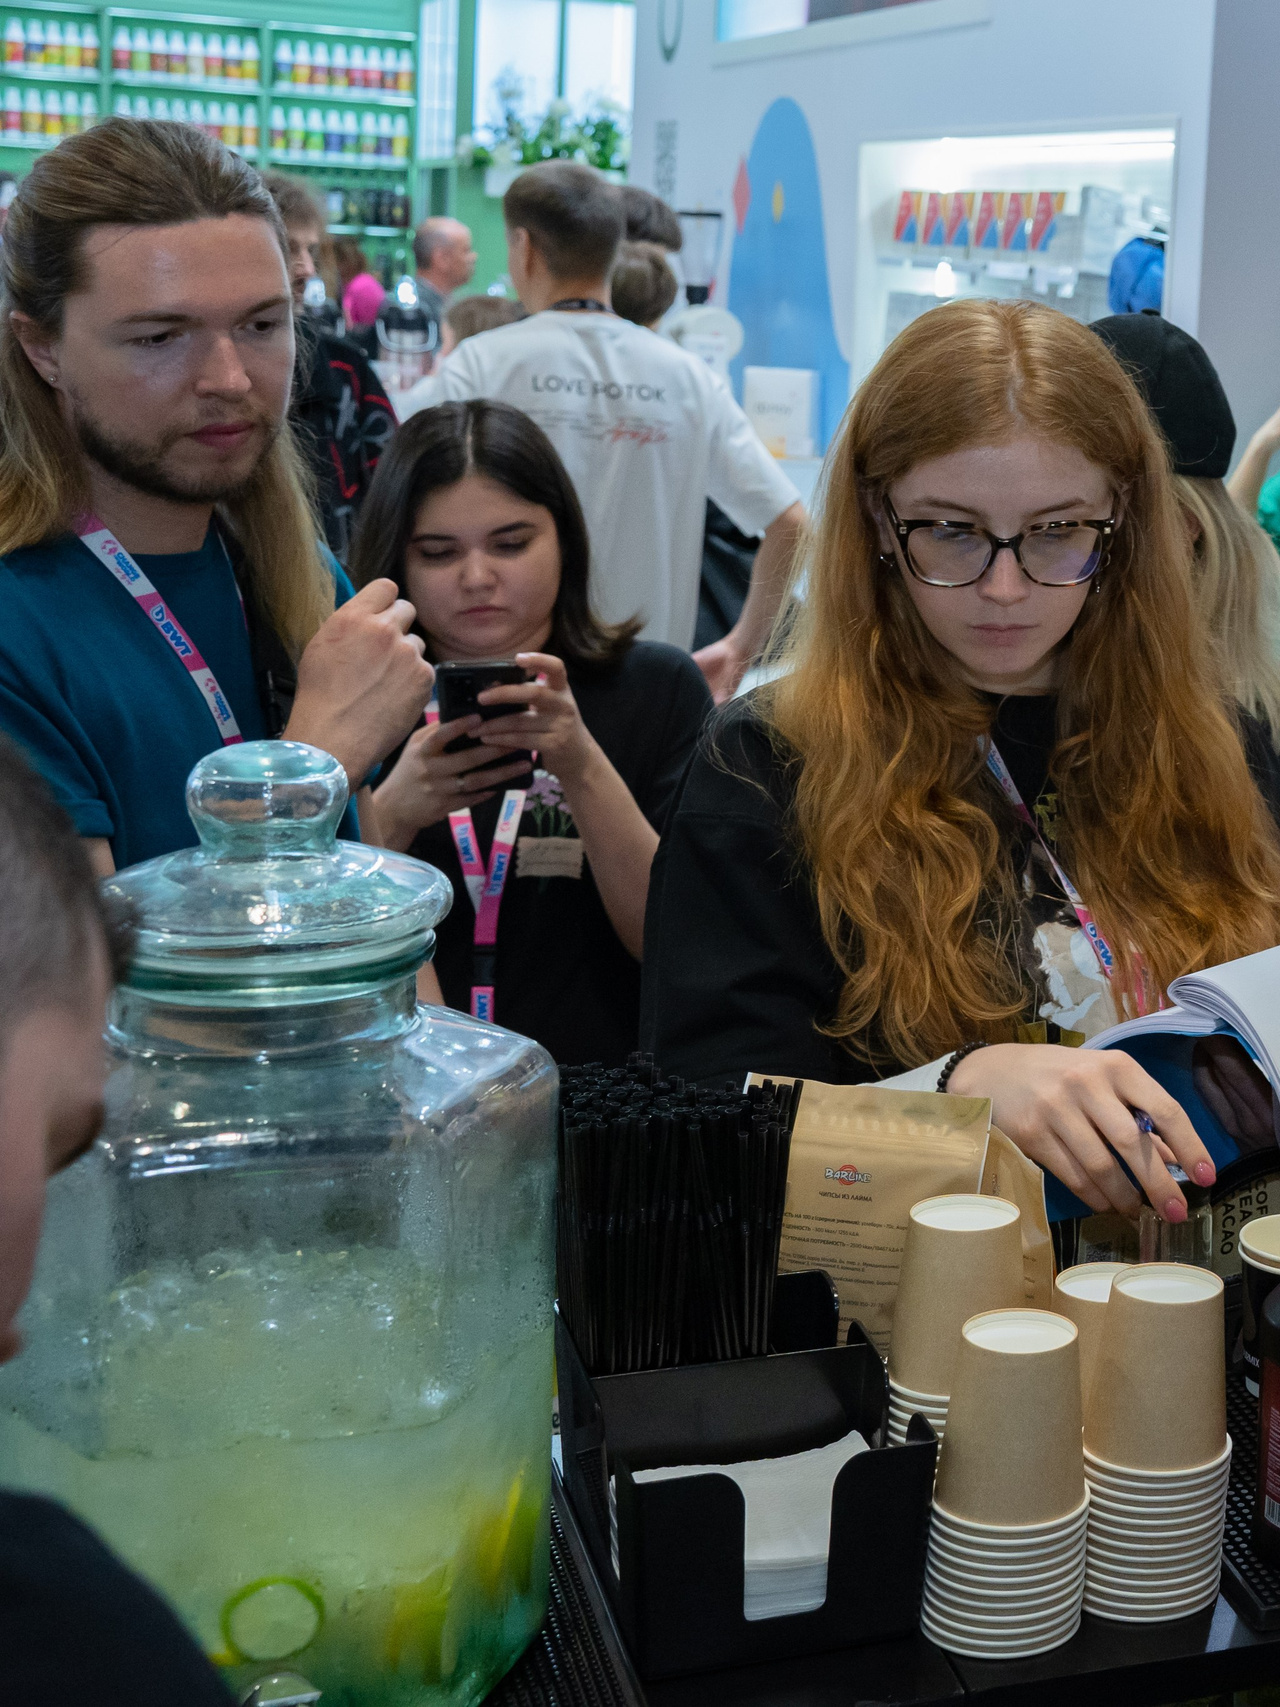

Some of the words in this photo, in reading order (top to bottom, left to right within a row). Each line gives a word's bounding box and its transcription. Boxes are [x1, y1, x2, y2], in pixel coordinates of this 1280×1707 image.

[531, 374, 587, 396] LOVE
[590, 381, 667, 404] POTOK
[161, 620, 193, 656] BWT
[477, 993, 489, 1021] WT
[824, 1167, 872, 1183] BARLINE
[819, 1191, 841, 1199] ЧИПСЫ
[850, 1194, 873, 1202] ЛАЙМА
[1255, 1180, 1268, 1215] COF
[1220, 1202, 1236, 1255] ACAO
